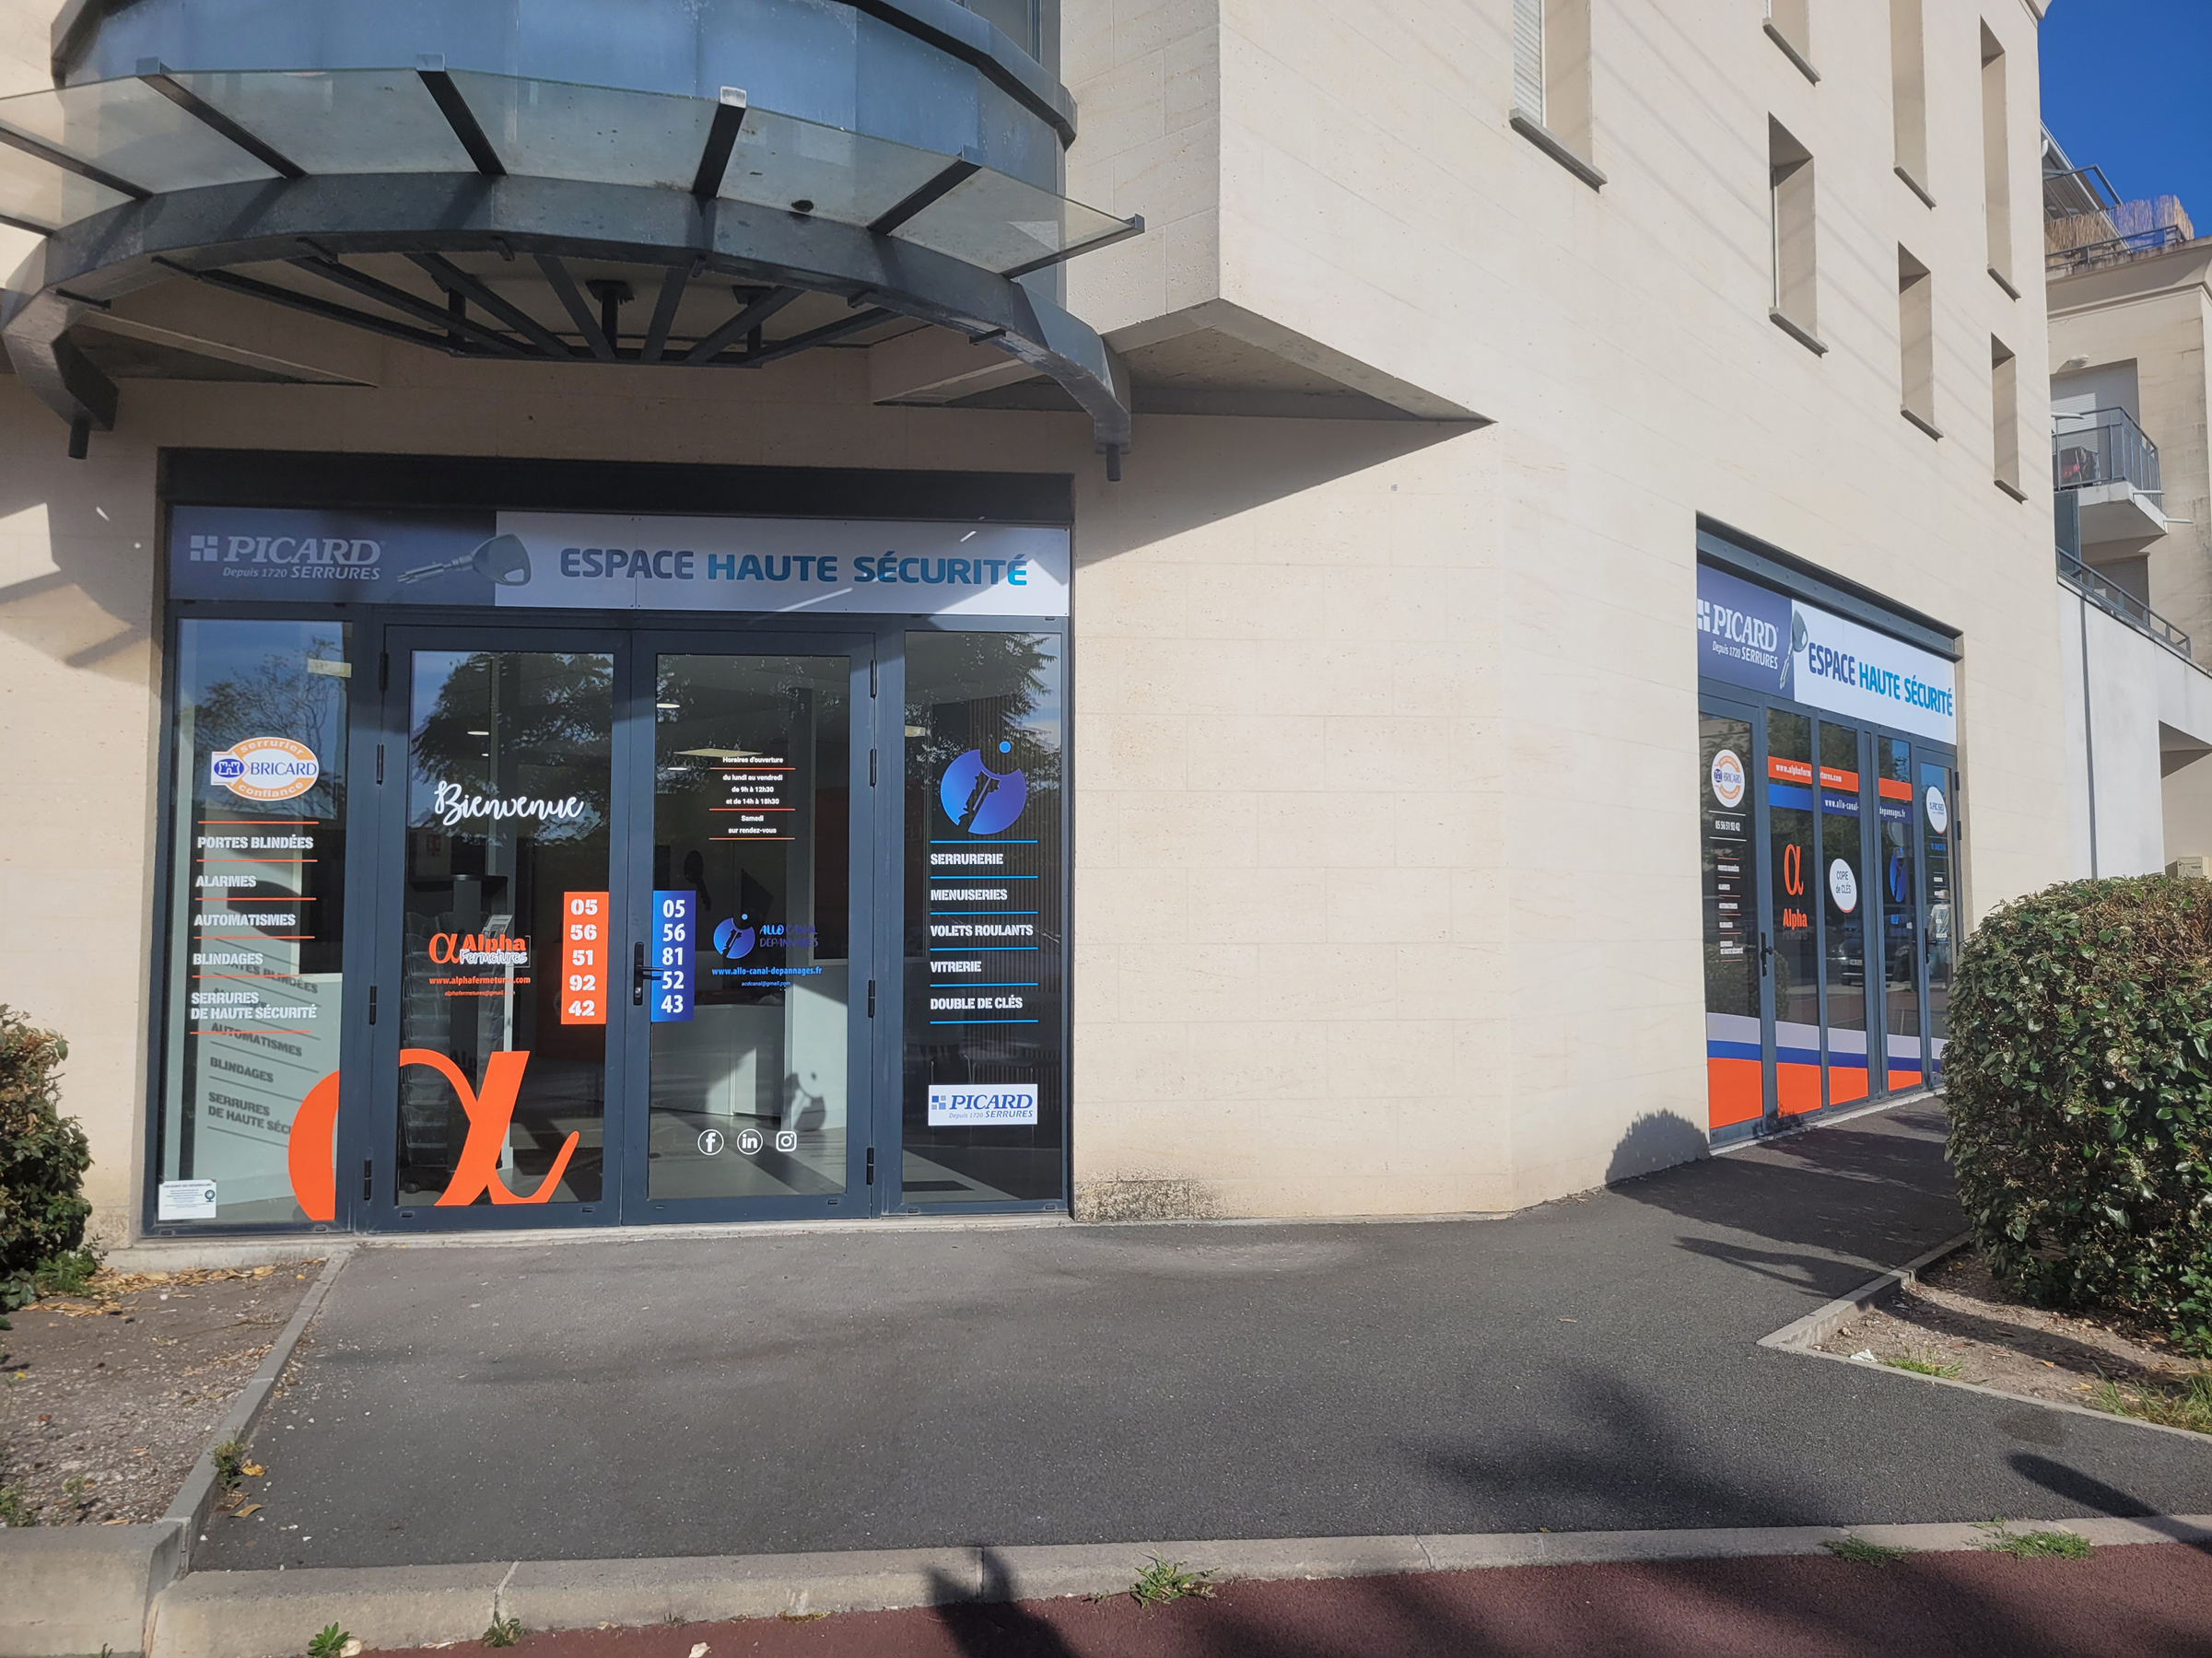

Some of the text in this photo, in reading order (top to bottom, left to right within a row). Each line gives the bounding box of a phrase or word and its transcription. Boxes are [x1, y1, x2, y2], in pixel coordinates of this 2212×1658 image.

[224, 536, 380, 565] PICARD
[223, 565, 380, 580] Depuis 1720 SERRURES
[560, 548, 1028, 586] ESPACE HAUTE SÉCURITÉ
[1713, 604, 1778, 652] PICARD
[1713, 640, 1778, 670] Depuis 1720 SERRURES
[1808, 642, 1953, 717] ESPACE HAUTE SÉCURITÉ
[240, 740, 304, 756] serrurier
[250, 762, 317, 776] BRICARD
[238, 781, 304, 798] confiance
[434, 780, 584, 825] Bienvenue
[197, 834, 313, 849] PORTES BLINDÉES
[930, 853, 1003, 866] SERRURERIE
[195, 875, 256, 888] ALARMES
[1836, 870, 1849, 881] COPIE
[930, 889, 1007, 901] MENUISERIES
[570, 898, 598, 916] 05
[662, 899, 685, 918] 05
[193, 914, 296, 927] AUTOMATISMES
[1783, 908, 1808, 930] Alpha
[570, 924, 597, 940] 56
[662, 923, 685, 942] 56
[759, 924, 785, 936] ALLO
[930, 924, 1033, 937] VOLETS ROULANTS
[462, 933, 526, 953] Alpha
[193, 952, 263, 965] BLINDAGES
[460, 948, 528, 964] Fermetures
[572, 950, 593, 965] 51
[661, 947, 683, 966] 81
[711, 966, 822, 976] www.allo-canal-depannages.fr
[930, 961, 982, 974] VITRERIE
[428, 975, 531, 986] www.alphafermetures.com
[568, 975, 596, 992] 92
[661, 971, 685, 990] 52
[191, 992, 259, 1005] SERRURES
[661, 994, 685, 1014] 43
[930, 994, 1023, 1010] DOUBLE DE CLÉS
[191, 1004, 317, 1020] DE HAUTE SÉCURITÉ
[568, 999, 595, 1017] 42
[951, 1093, 1033, 1109] PICARD
[949, 1112, 967, 1120] Depuis
[985, 1109, 1033, 1118] SERRURES
